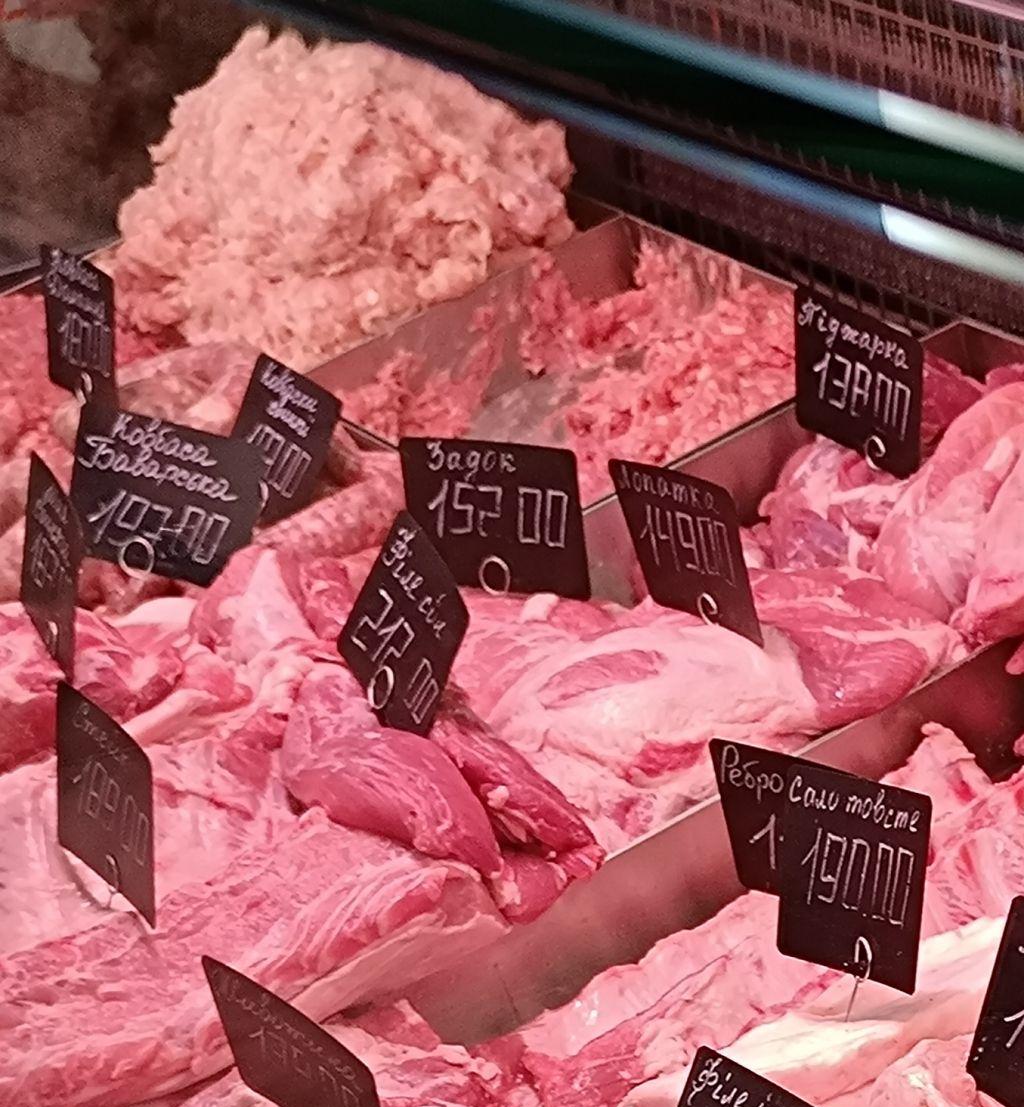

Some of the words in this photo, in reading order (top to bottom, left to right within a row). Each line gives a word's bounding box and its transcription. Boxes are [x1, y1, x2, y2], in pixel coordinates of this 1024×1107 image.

[426, 440, 517, 482] Задок
[720, 743, 785, 804] Ребро
[845, 787, 922, 833] товсте
